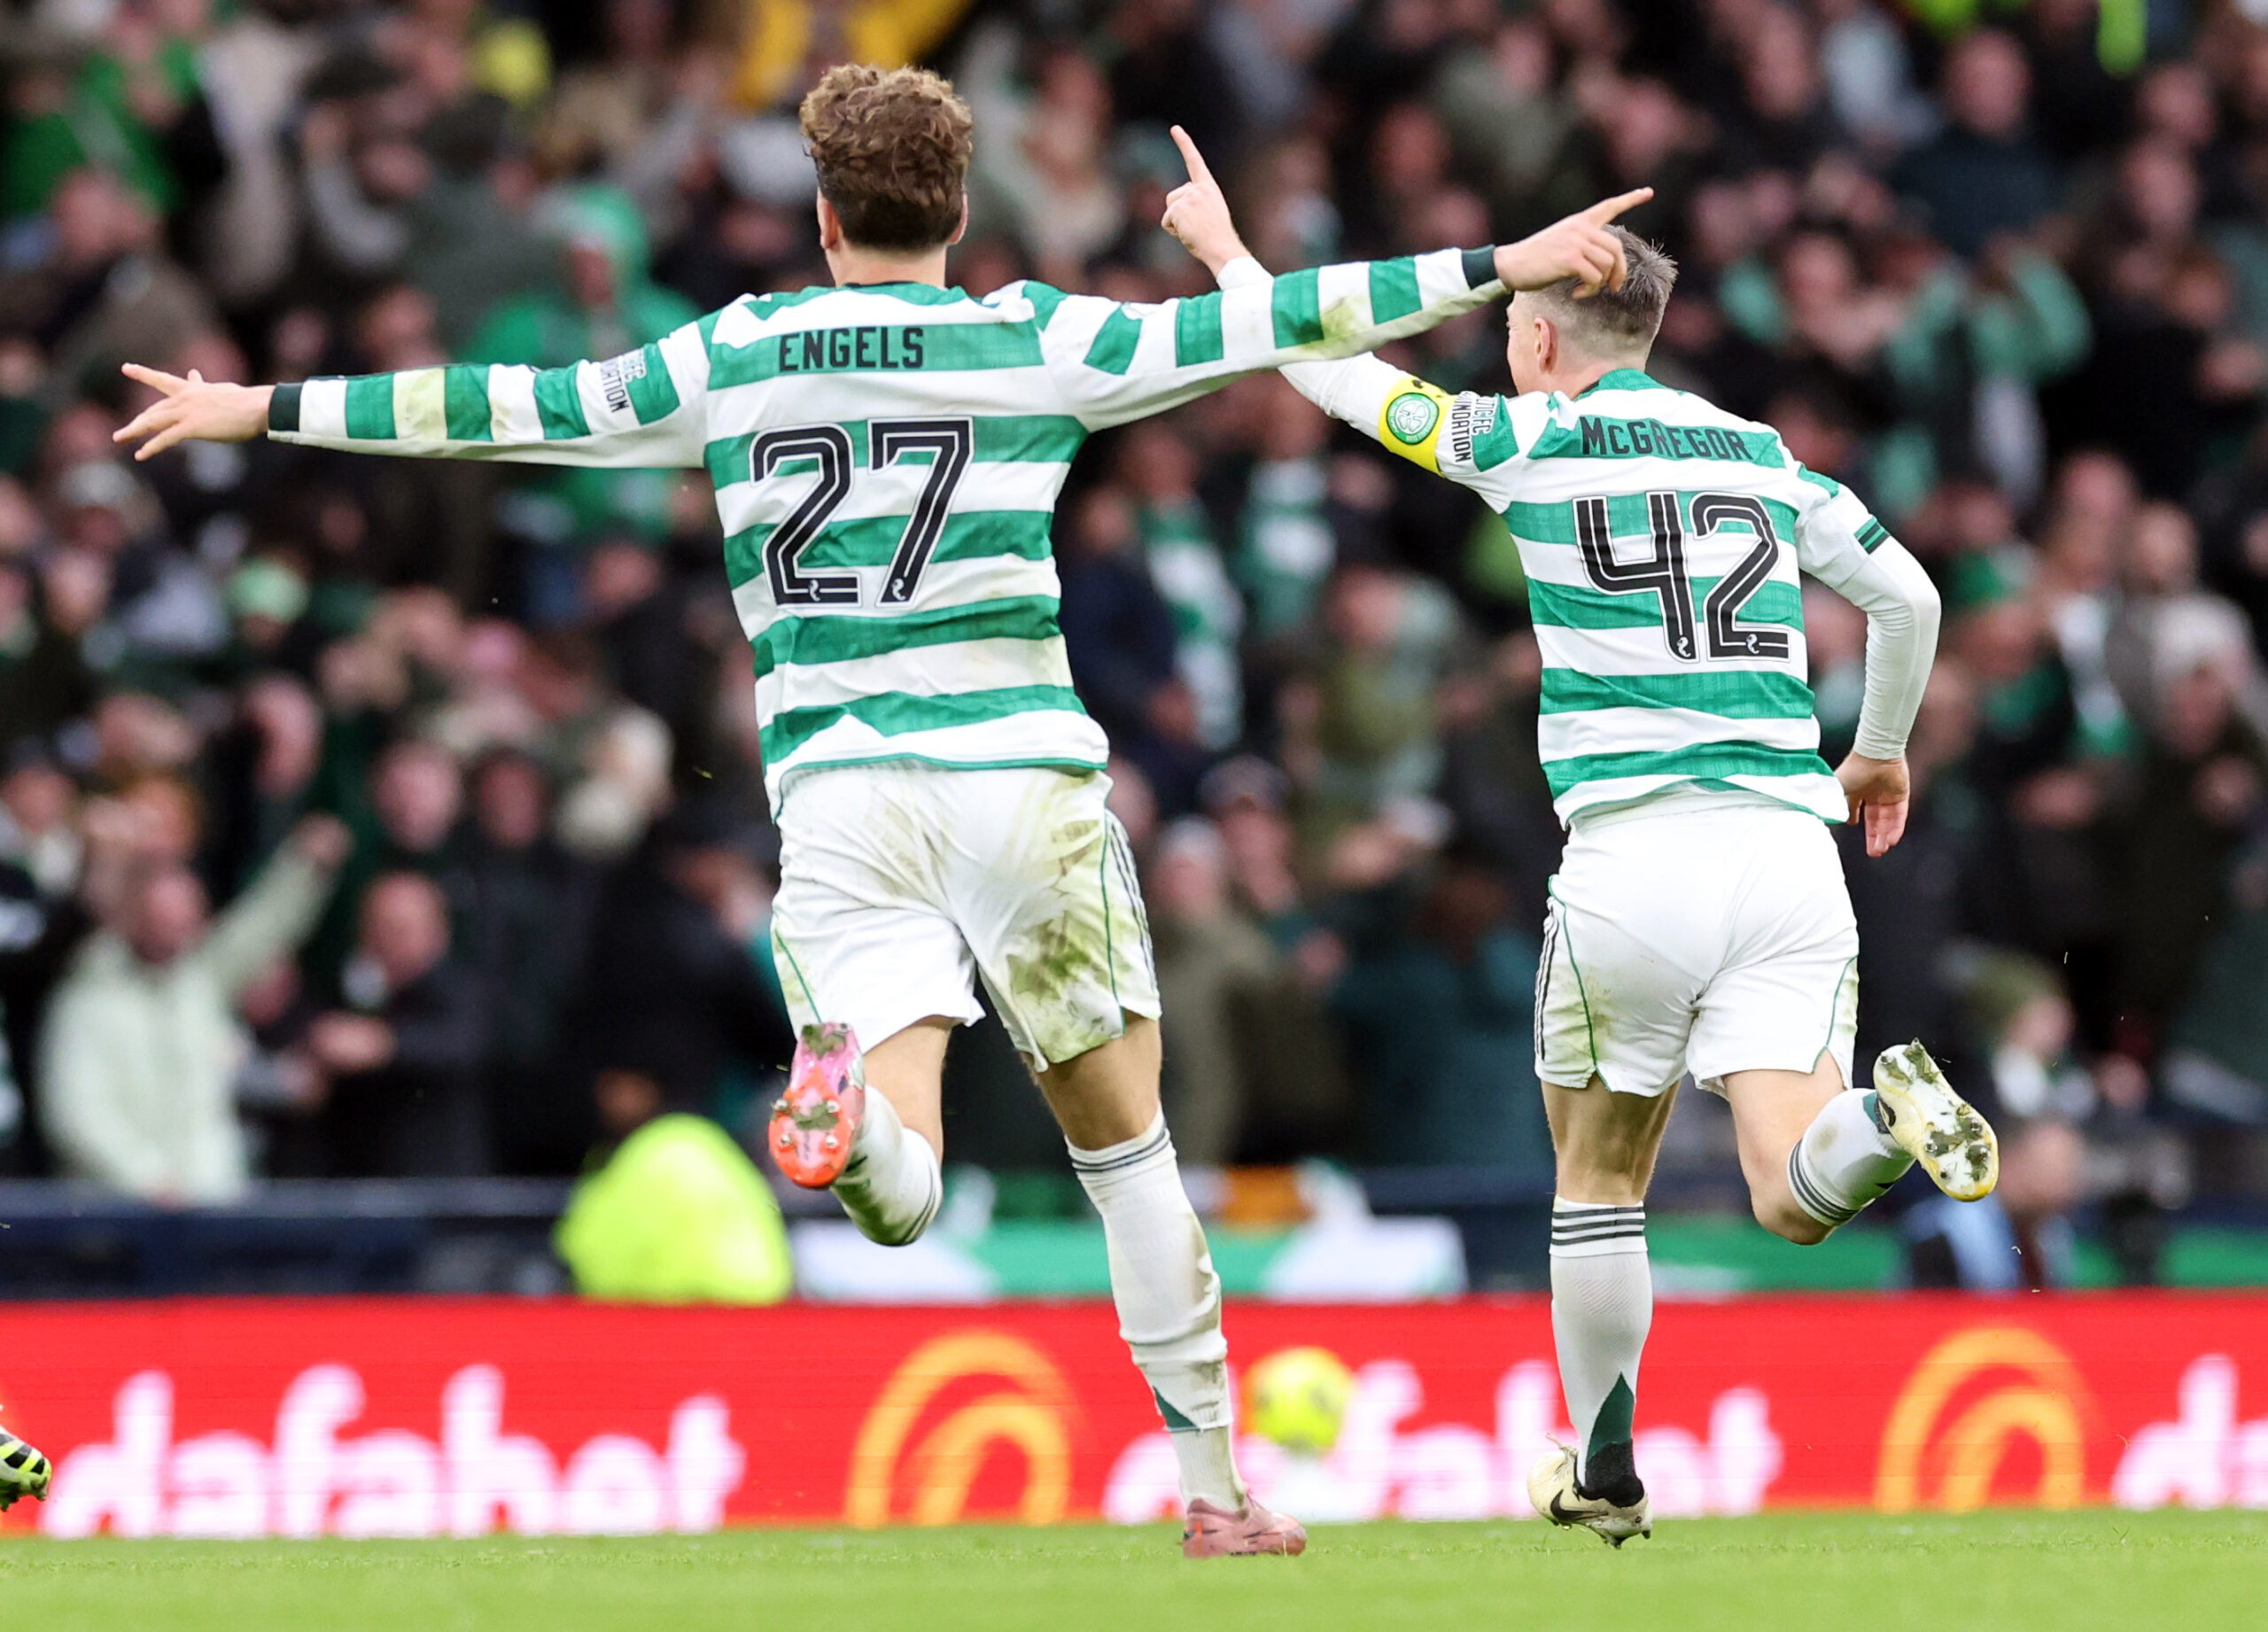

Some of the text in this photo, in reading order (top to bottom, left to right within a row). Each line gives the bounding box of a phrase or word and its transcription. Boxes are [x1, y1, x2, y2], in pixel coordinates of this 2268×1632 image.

[779, 326, 924, 373] ENGELS
[1472, 418, 1493, 434] FC
[1580, 416, 1753, 461] McGREGOR
[750, 416, 975, 609] 27
[1573, 490, 1791, 664] 42
